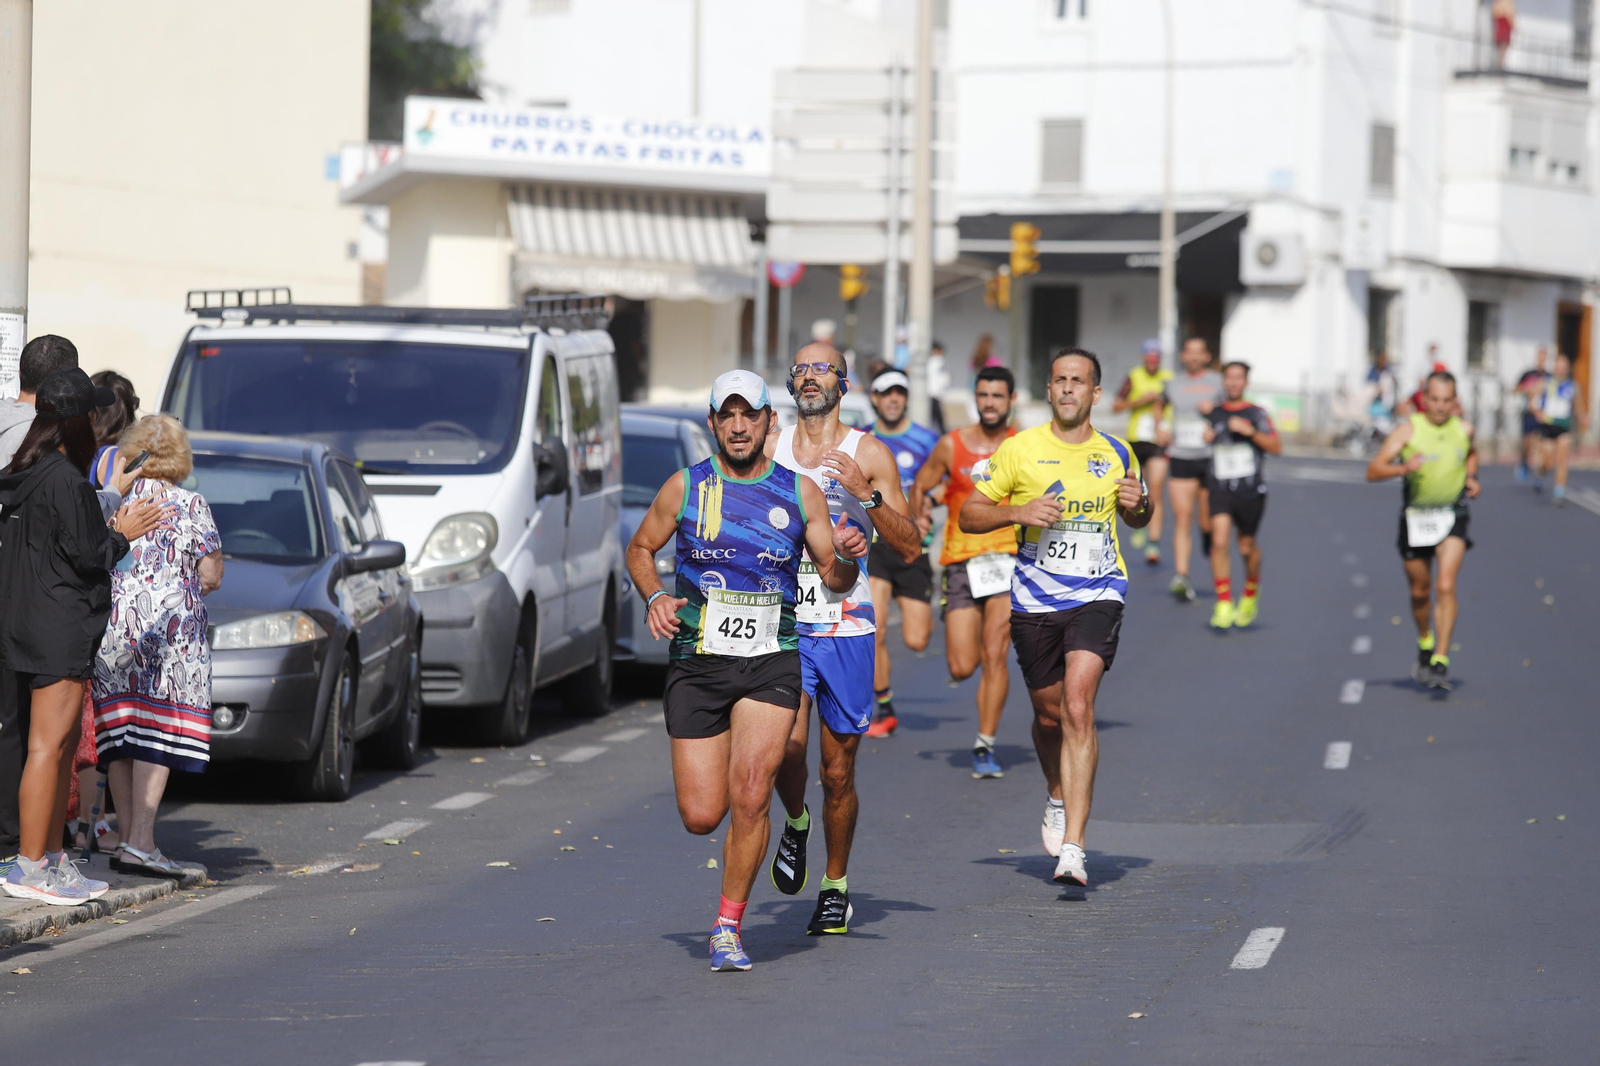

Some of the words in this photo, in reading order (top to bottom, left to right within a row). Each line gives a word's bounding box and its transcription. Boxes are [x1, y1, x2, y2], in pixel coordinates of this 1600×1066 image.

[490, 136, 629, 159] PATATAS
[639, 147, 745, 167] FRITAS
[691, 548, 736, 559] aecc
[1047, 540, 1077, 560] 521
[714, 592, 722, 600] 34
[723, 593, 748, 604] VUELTA
[749, 596, 755, 605] A
[756, 595, 778, 606] HUELVA
[722, 604, 753, 612] SEBASTIAN
[718, 616, 757, 640] 425
